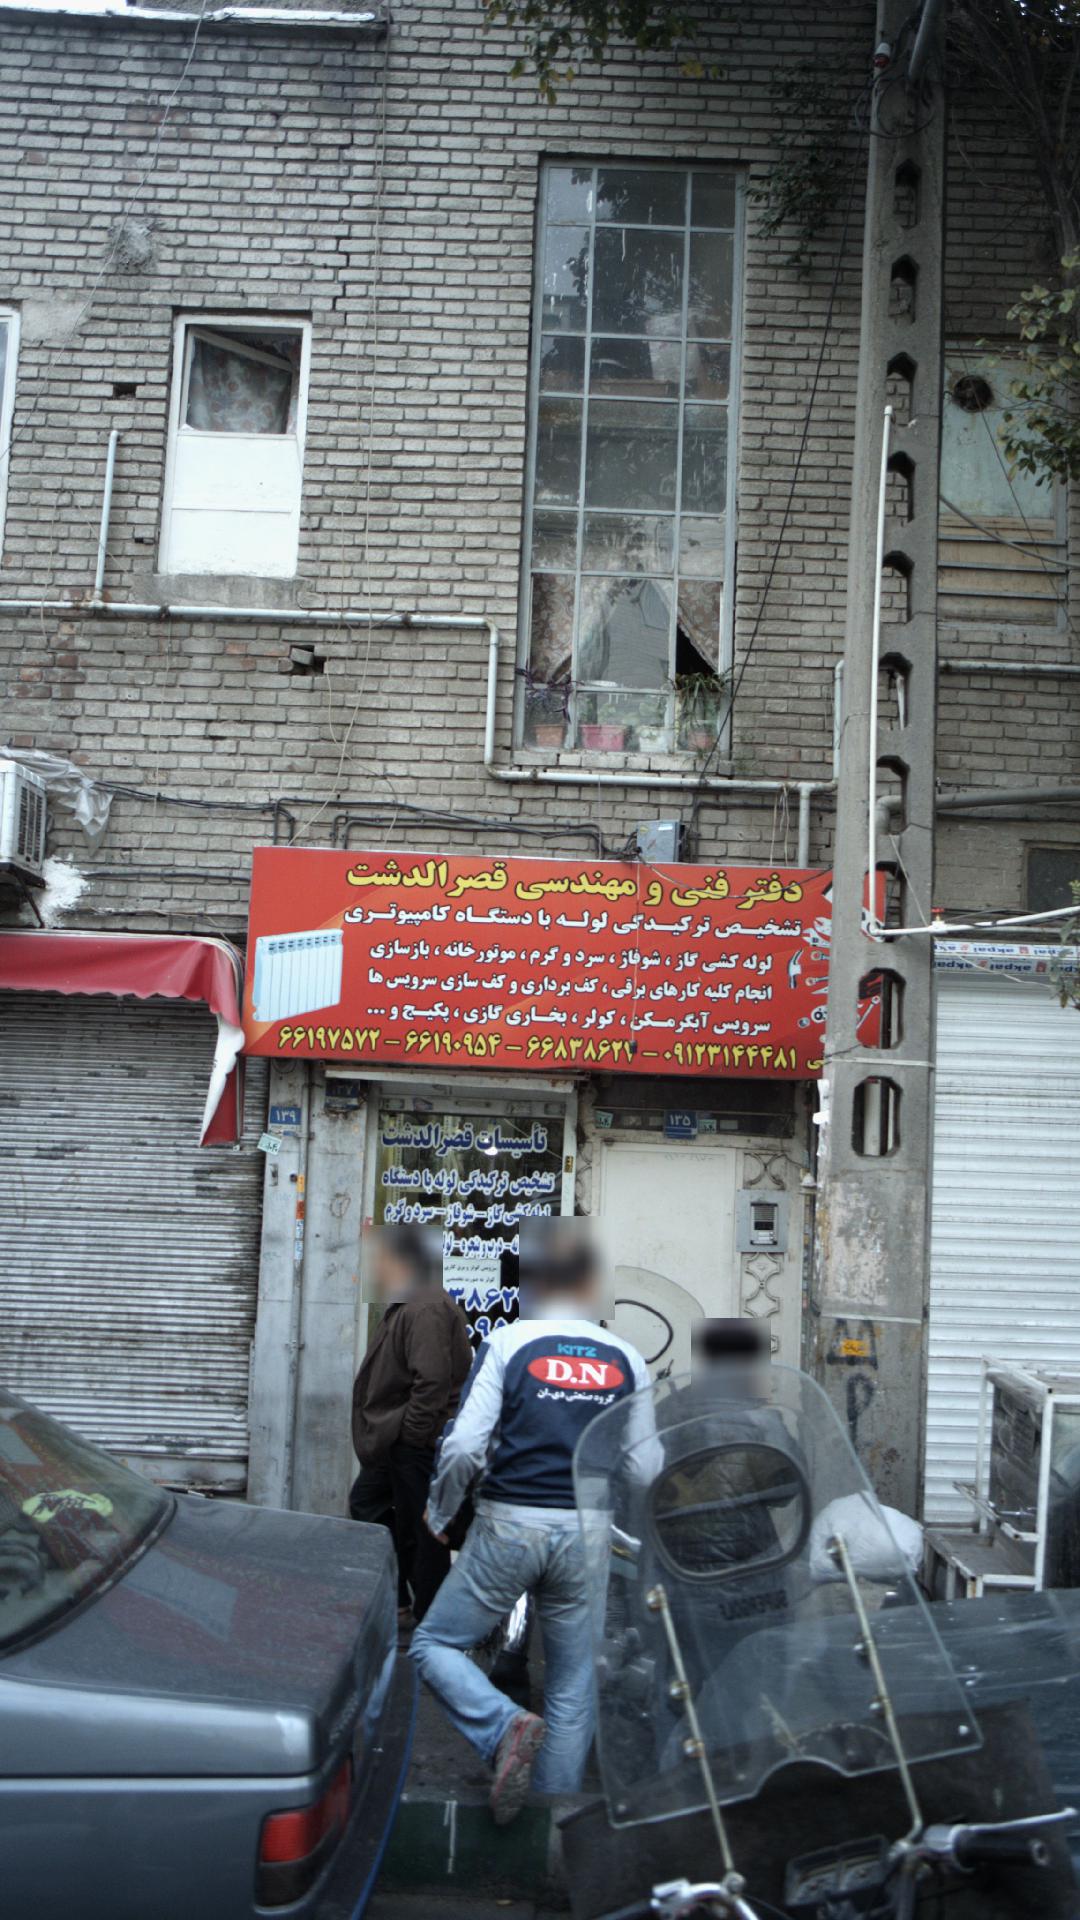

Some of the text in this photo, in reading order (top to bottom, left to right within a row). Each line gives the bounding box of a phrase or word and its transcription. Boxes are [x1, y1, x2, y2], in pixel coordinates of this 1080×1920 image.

[346, 859, 802, 909] دفتر فنی و مهندسی قصر الدشت
[343, 903, 802, 939] تشخیص ترکیدگی لوله با دستگاه کامپیوتری
[369, 939, 430, 960] بازسازی
[562, 949, 571, 964] و
[574, 950, 605, 967] سرد
[701, 953, 739, 973] کشی
[742, 954, 773, 976] لوله
[367, 968, 384, 984] ها
[385, 974, 438, 990] سرویس
[439, 972, 480, 991] سازی
[481, 974, 506, 990] کف
[573, 977, 599, 994] کف
[509, 983, 518, 995] و
[520, 977, 571, 997] برداری
[648, 980, 701, 1000] کارهای
[703, 983, 732, 1002] کلیه
[734, 985, 773, 1004] انجام
[389, 1008, 398, 1020] و
[401, 1002, 450, 1023] پکیج
[505, 1004, 568, 1025] بخاری
[712, 1019, 771, 1035] سرویس
[278, 1026, 381, 1052] ۶۶۱۹۷۵۷۲
[404, 1030, 502, 1057] ۶۶۱۹۰۹۵۴
[663, 1041, 797, 1069] ۰۹۱۲۳۱۴۴۴۸۱
[275, 1109, 296, 1118] ۱۳۹
[669, 1114, 692, 1126] ۱۳۵
[381, 1121, 548, 1158] تأسیسات قصر الدشت
[382, 1165, 555, 1198] تشخیص ترکیدگی لوله با دستگاه
[384, 1197, 406, 1221] گرم
[403, 1205, 414, 1222] و
[413, 1202, 435, 1222] سرد
[485, 1203, 505, 1228] گاز
[557, 1343, 597, 1358] KITZ
[545, 1358, 609, 1386] D.N
[565, 1391, 593, 1403] صنعتی
[593, 1394, 615, 1406] گروه
